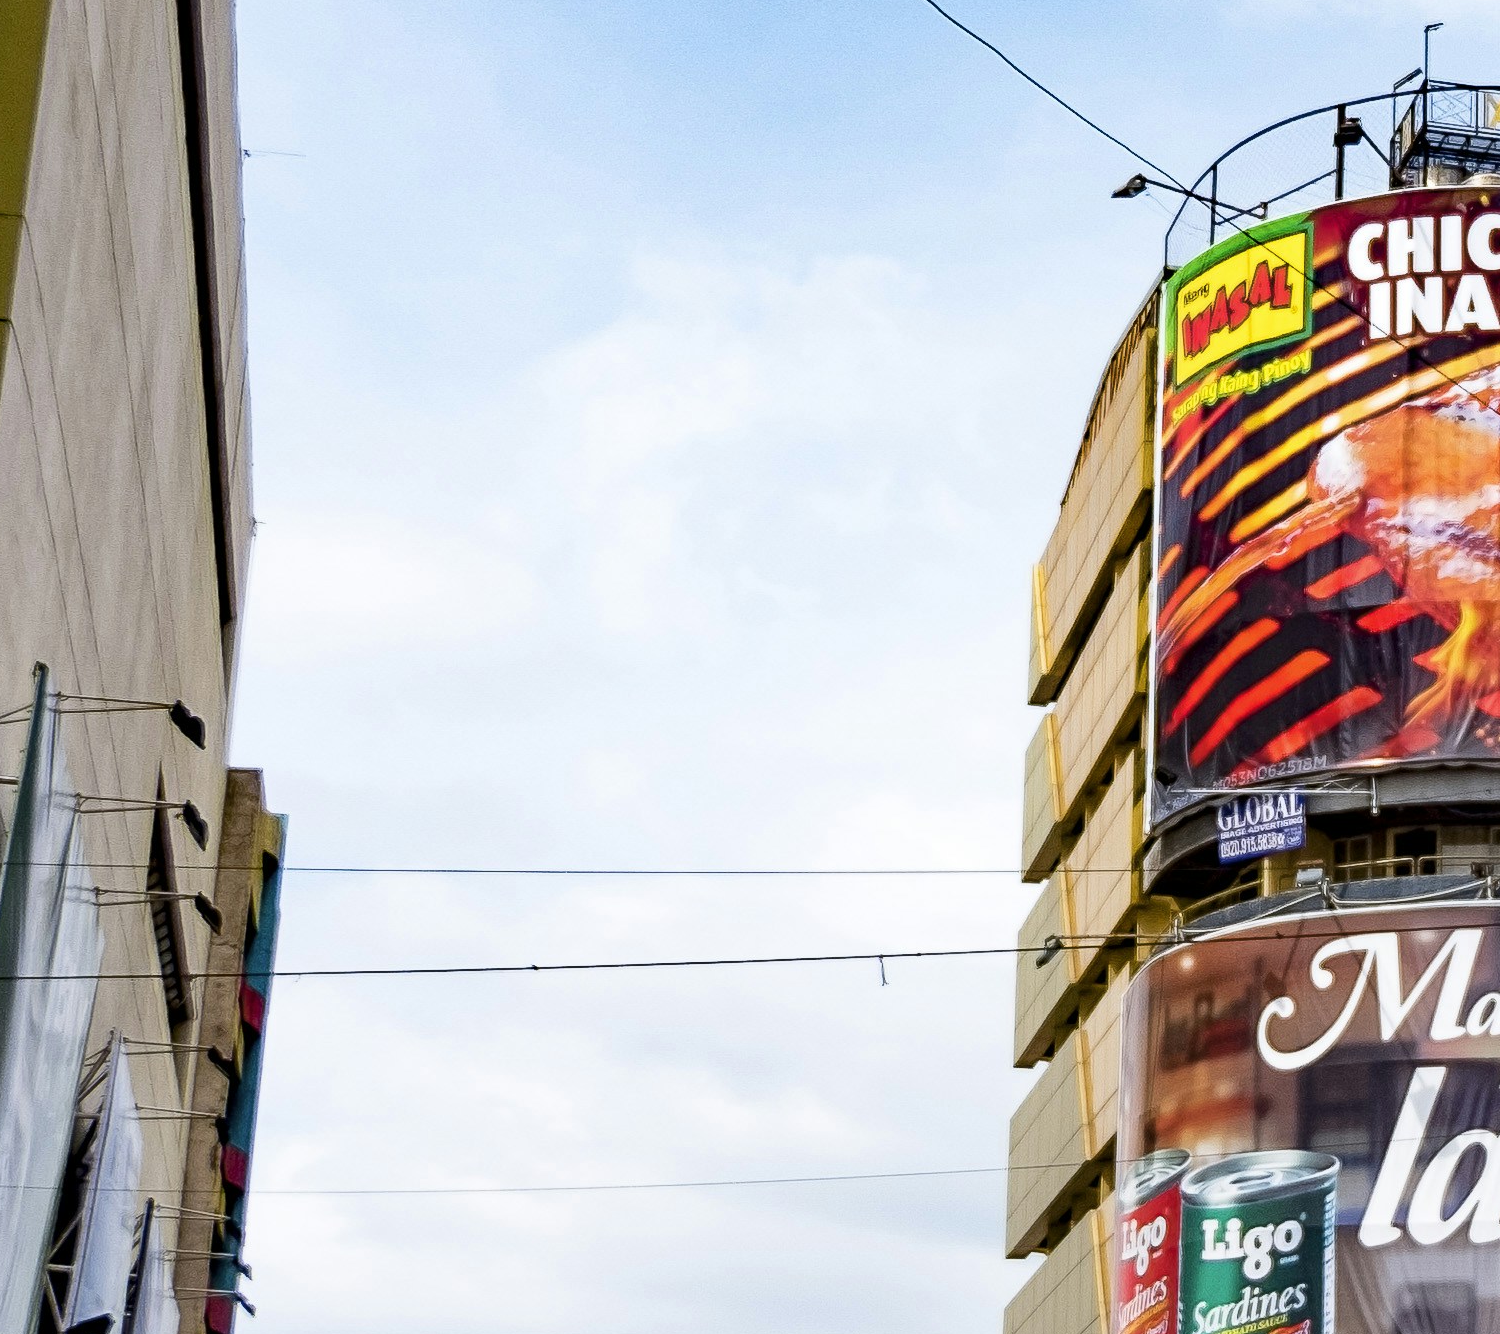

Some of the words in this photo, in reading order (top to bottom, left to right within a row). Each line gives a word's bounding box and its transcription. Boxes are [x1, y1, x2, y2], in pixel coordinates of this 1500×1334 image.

[1262, 349, 1312, 385] Pinoy
[1217, 789, 1303, 832] GLOBAL
[1119, 1214, 1168, 1277] Ligo
[1201, 1217, 1304, 1282] Ligo
